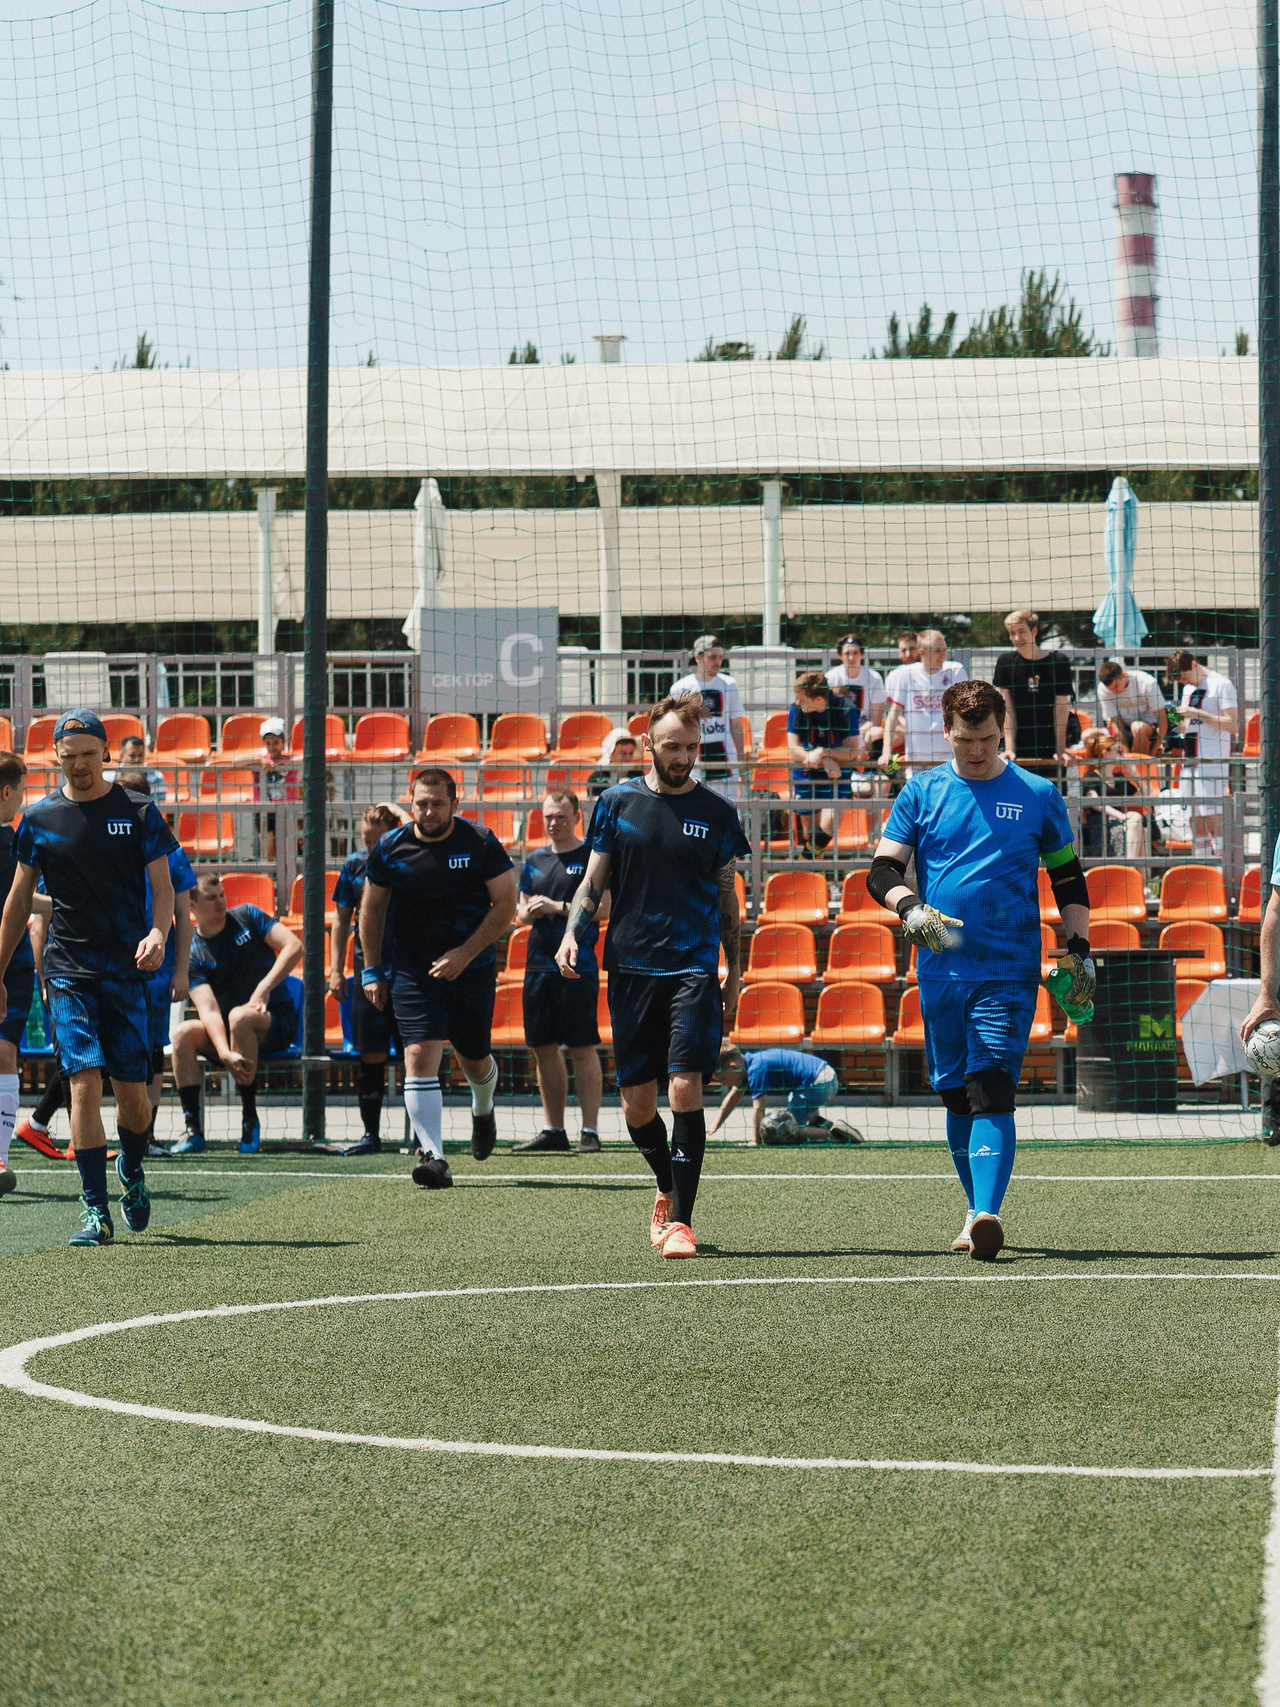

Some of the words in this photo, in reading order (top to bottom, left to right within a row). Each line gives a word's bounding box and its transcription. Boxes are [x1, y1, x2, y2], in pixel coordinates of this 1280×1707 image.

[995, 806, 1023, 821] UIT
[107, 822, 132, 835] UIT
[682, 822, 709, 839] UIT
[448, 857, 471, 869] UIT
[235, 930, 251, 946] UIT
